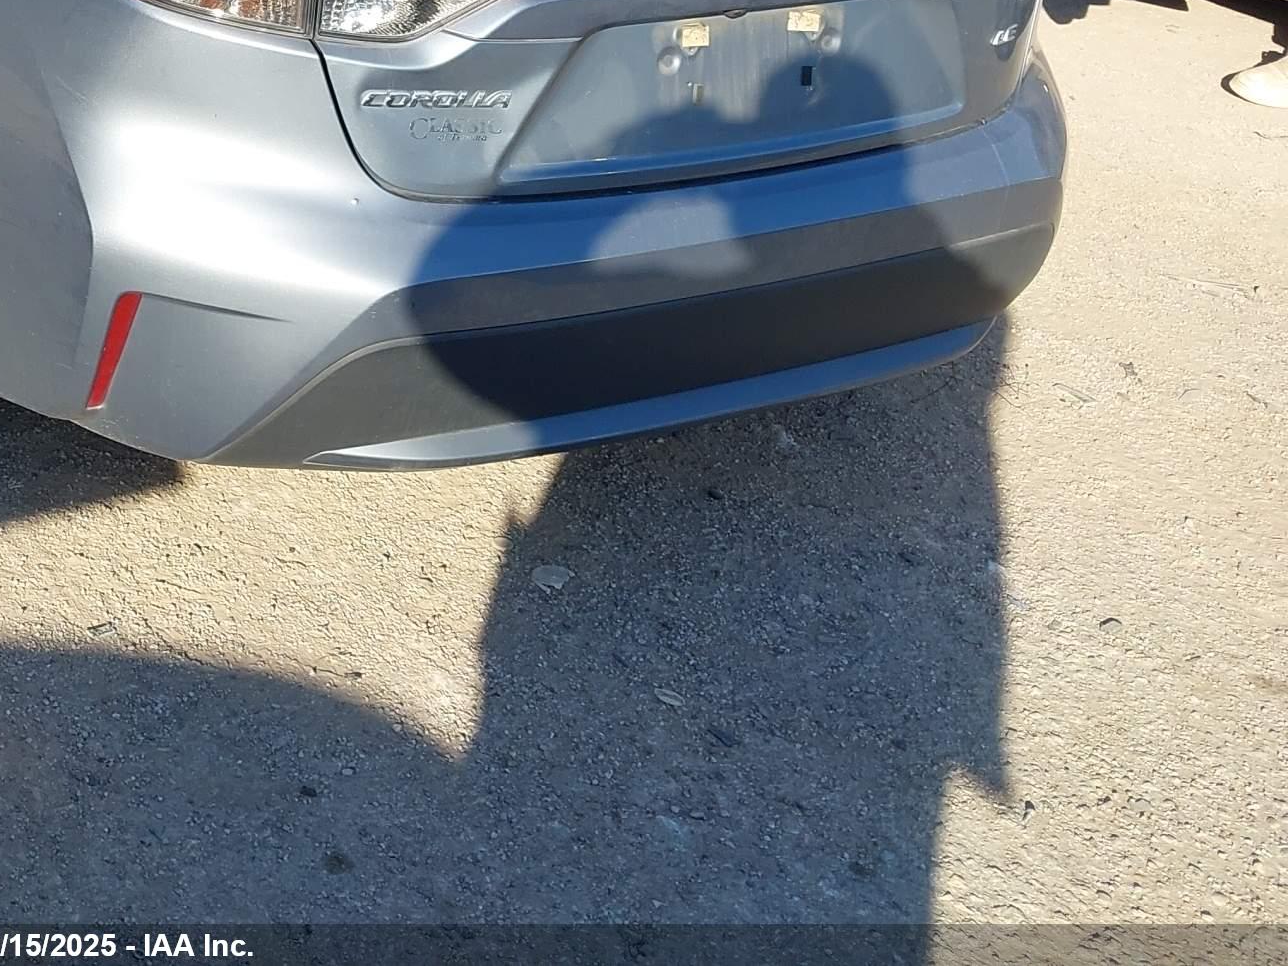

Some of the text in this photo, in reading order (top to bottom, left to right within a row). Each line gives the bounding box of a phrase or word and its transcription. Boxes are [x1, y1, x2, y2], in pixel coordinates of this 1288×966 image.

[990, 23, 1018, 46] LE
[360, 89, 512, 109] COROLLA
[409, 117, 503, 140] CLASSIC
